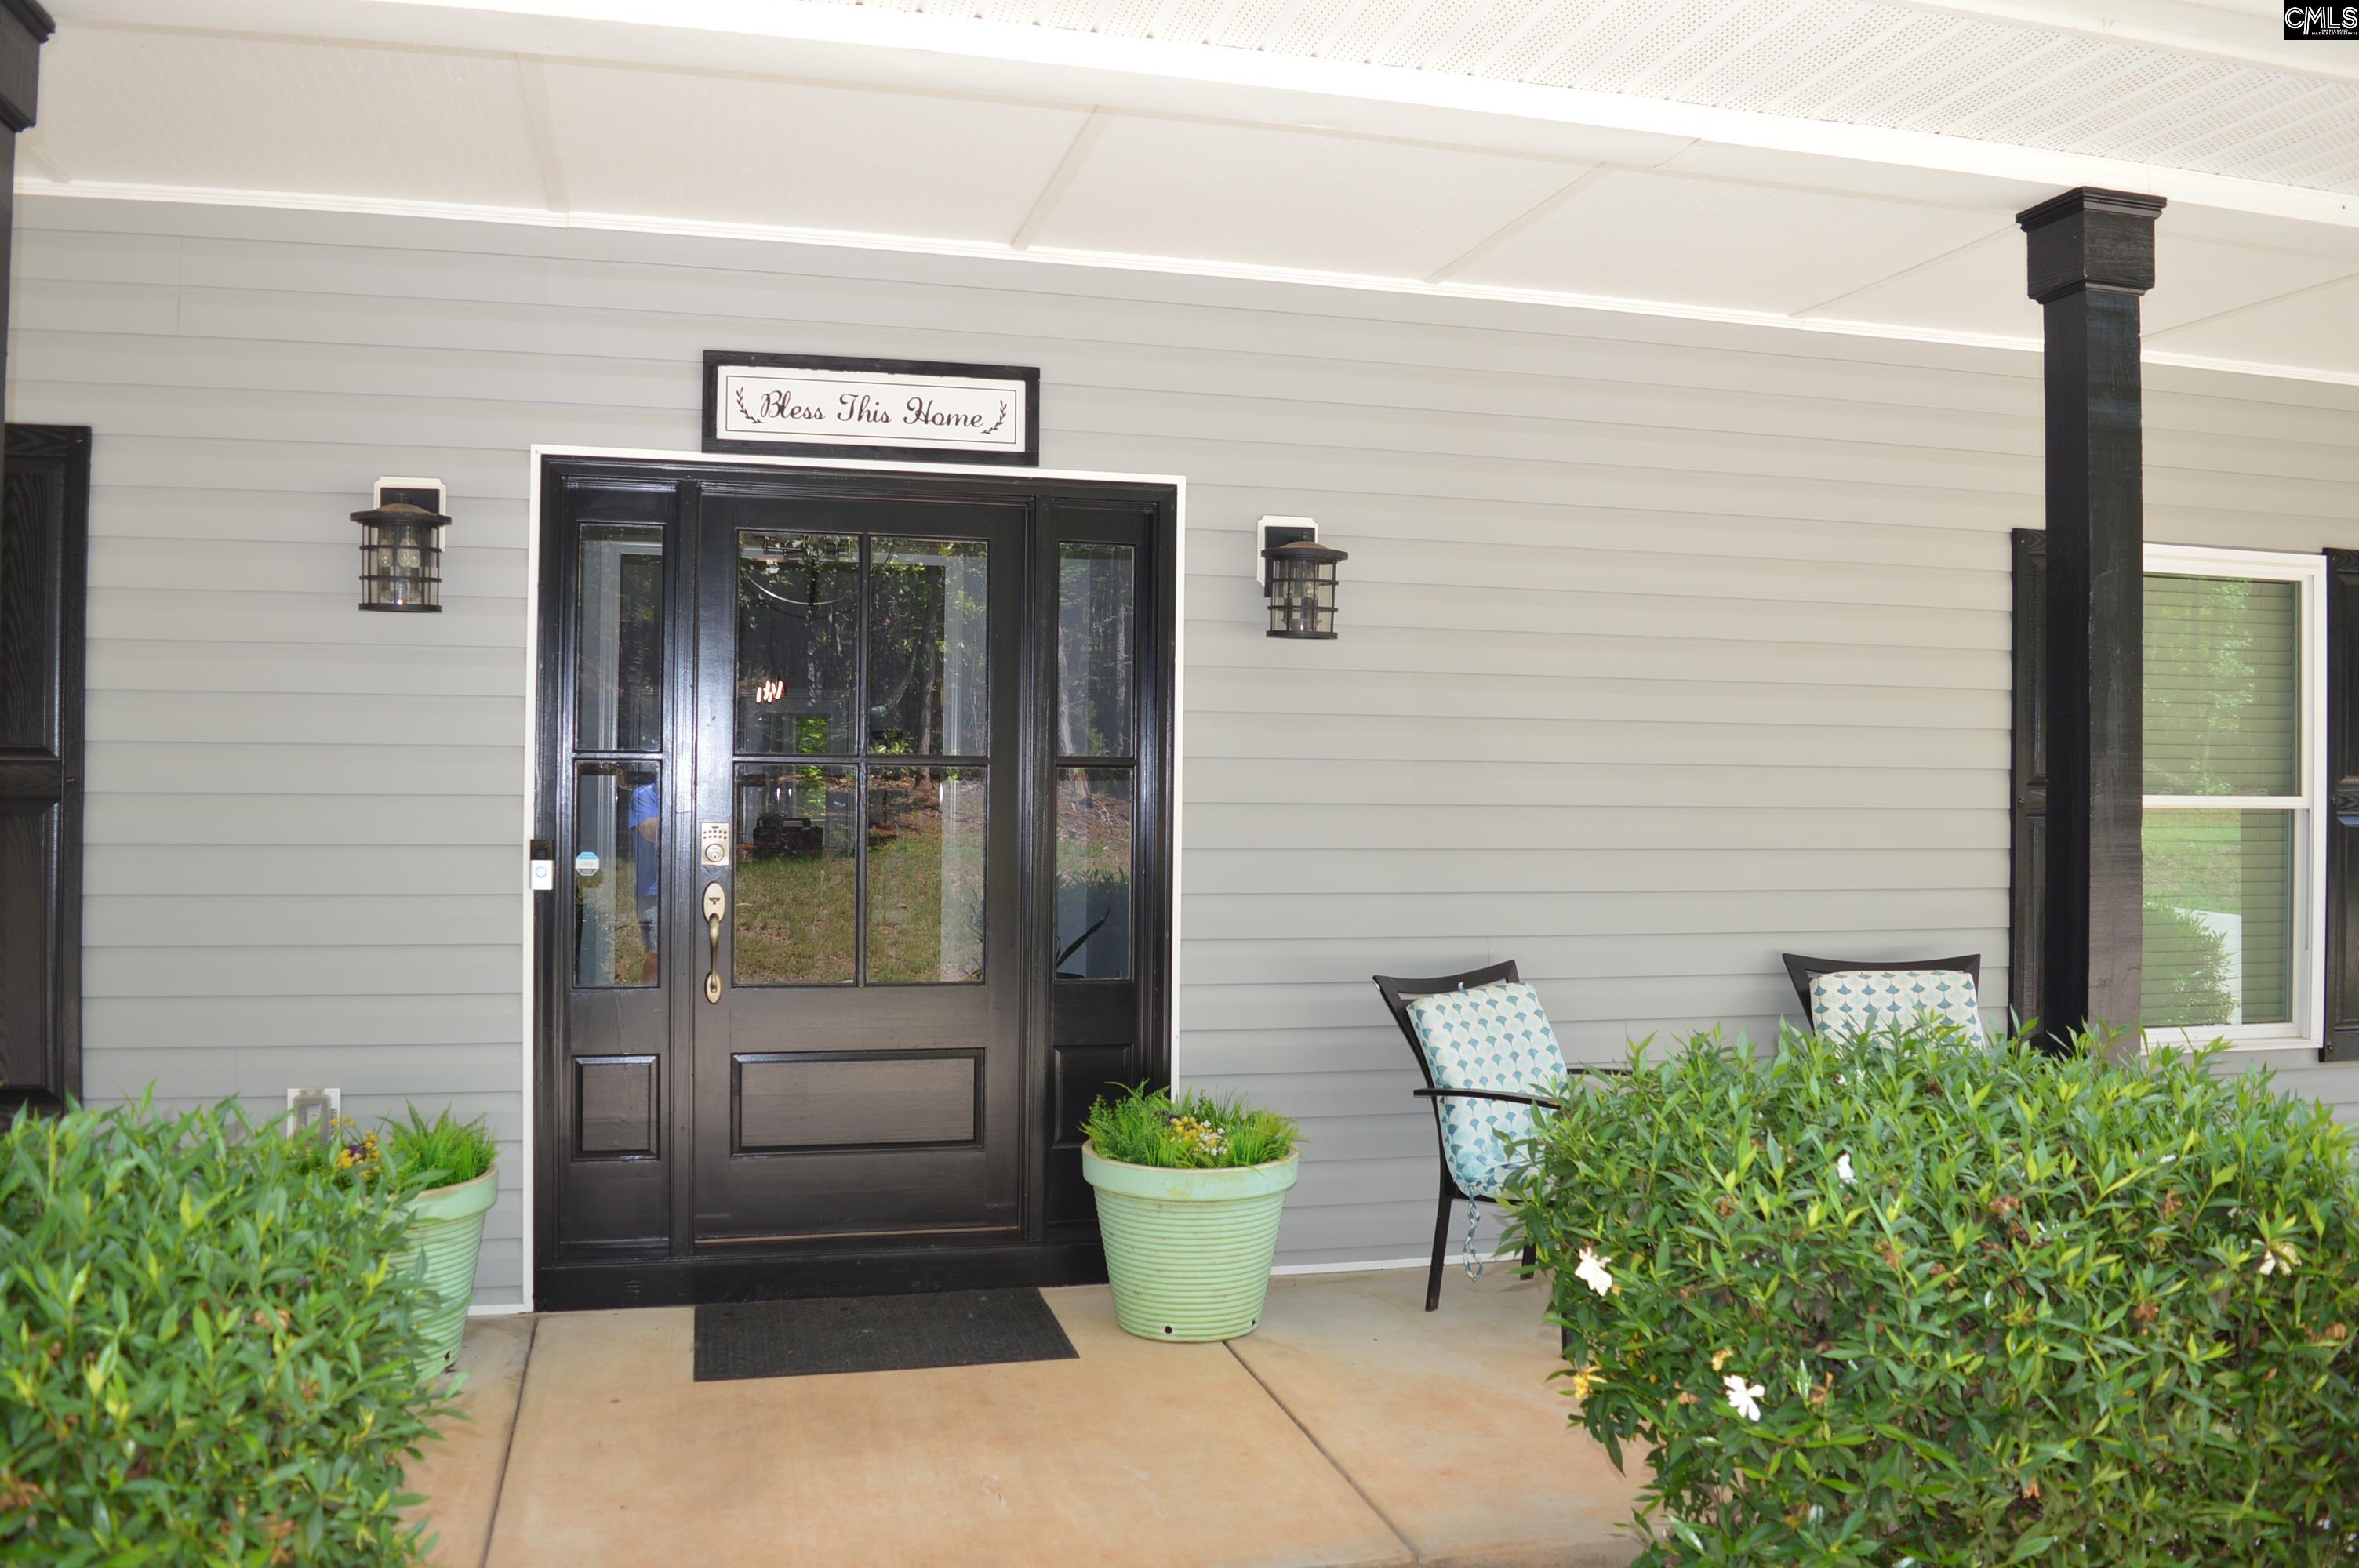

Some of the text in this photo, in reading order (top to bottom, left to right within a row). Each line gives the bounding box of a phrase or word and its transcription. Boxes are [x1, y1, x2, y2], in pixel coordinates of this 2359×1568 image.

[760, 390, 984, 428] Bless This Home
